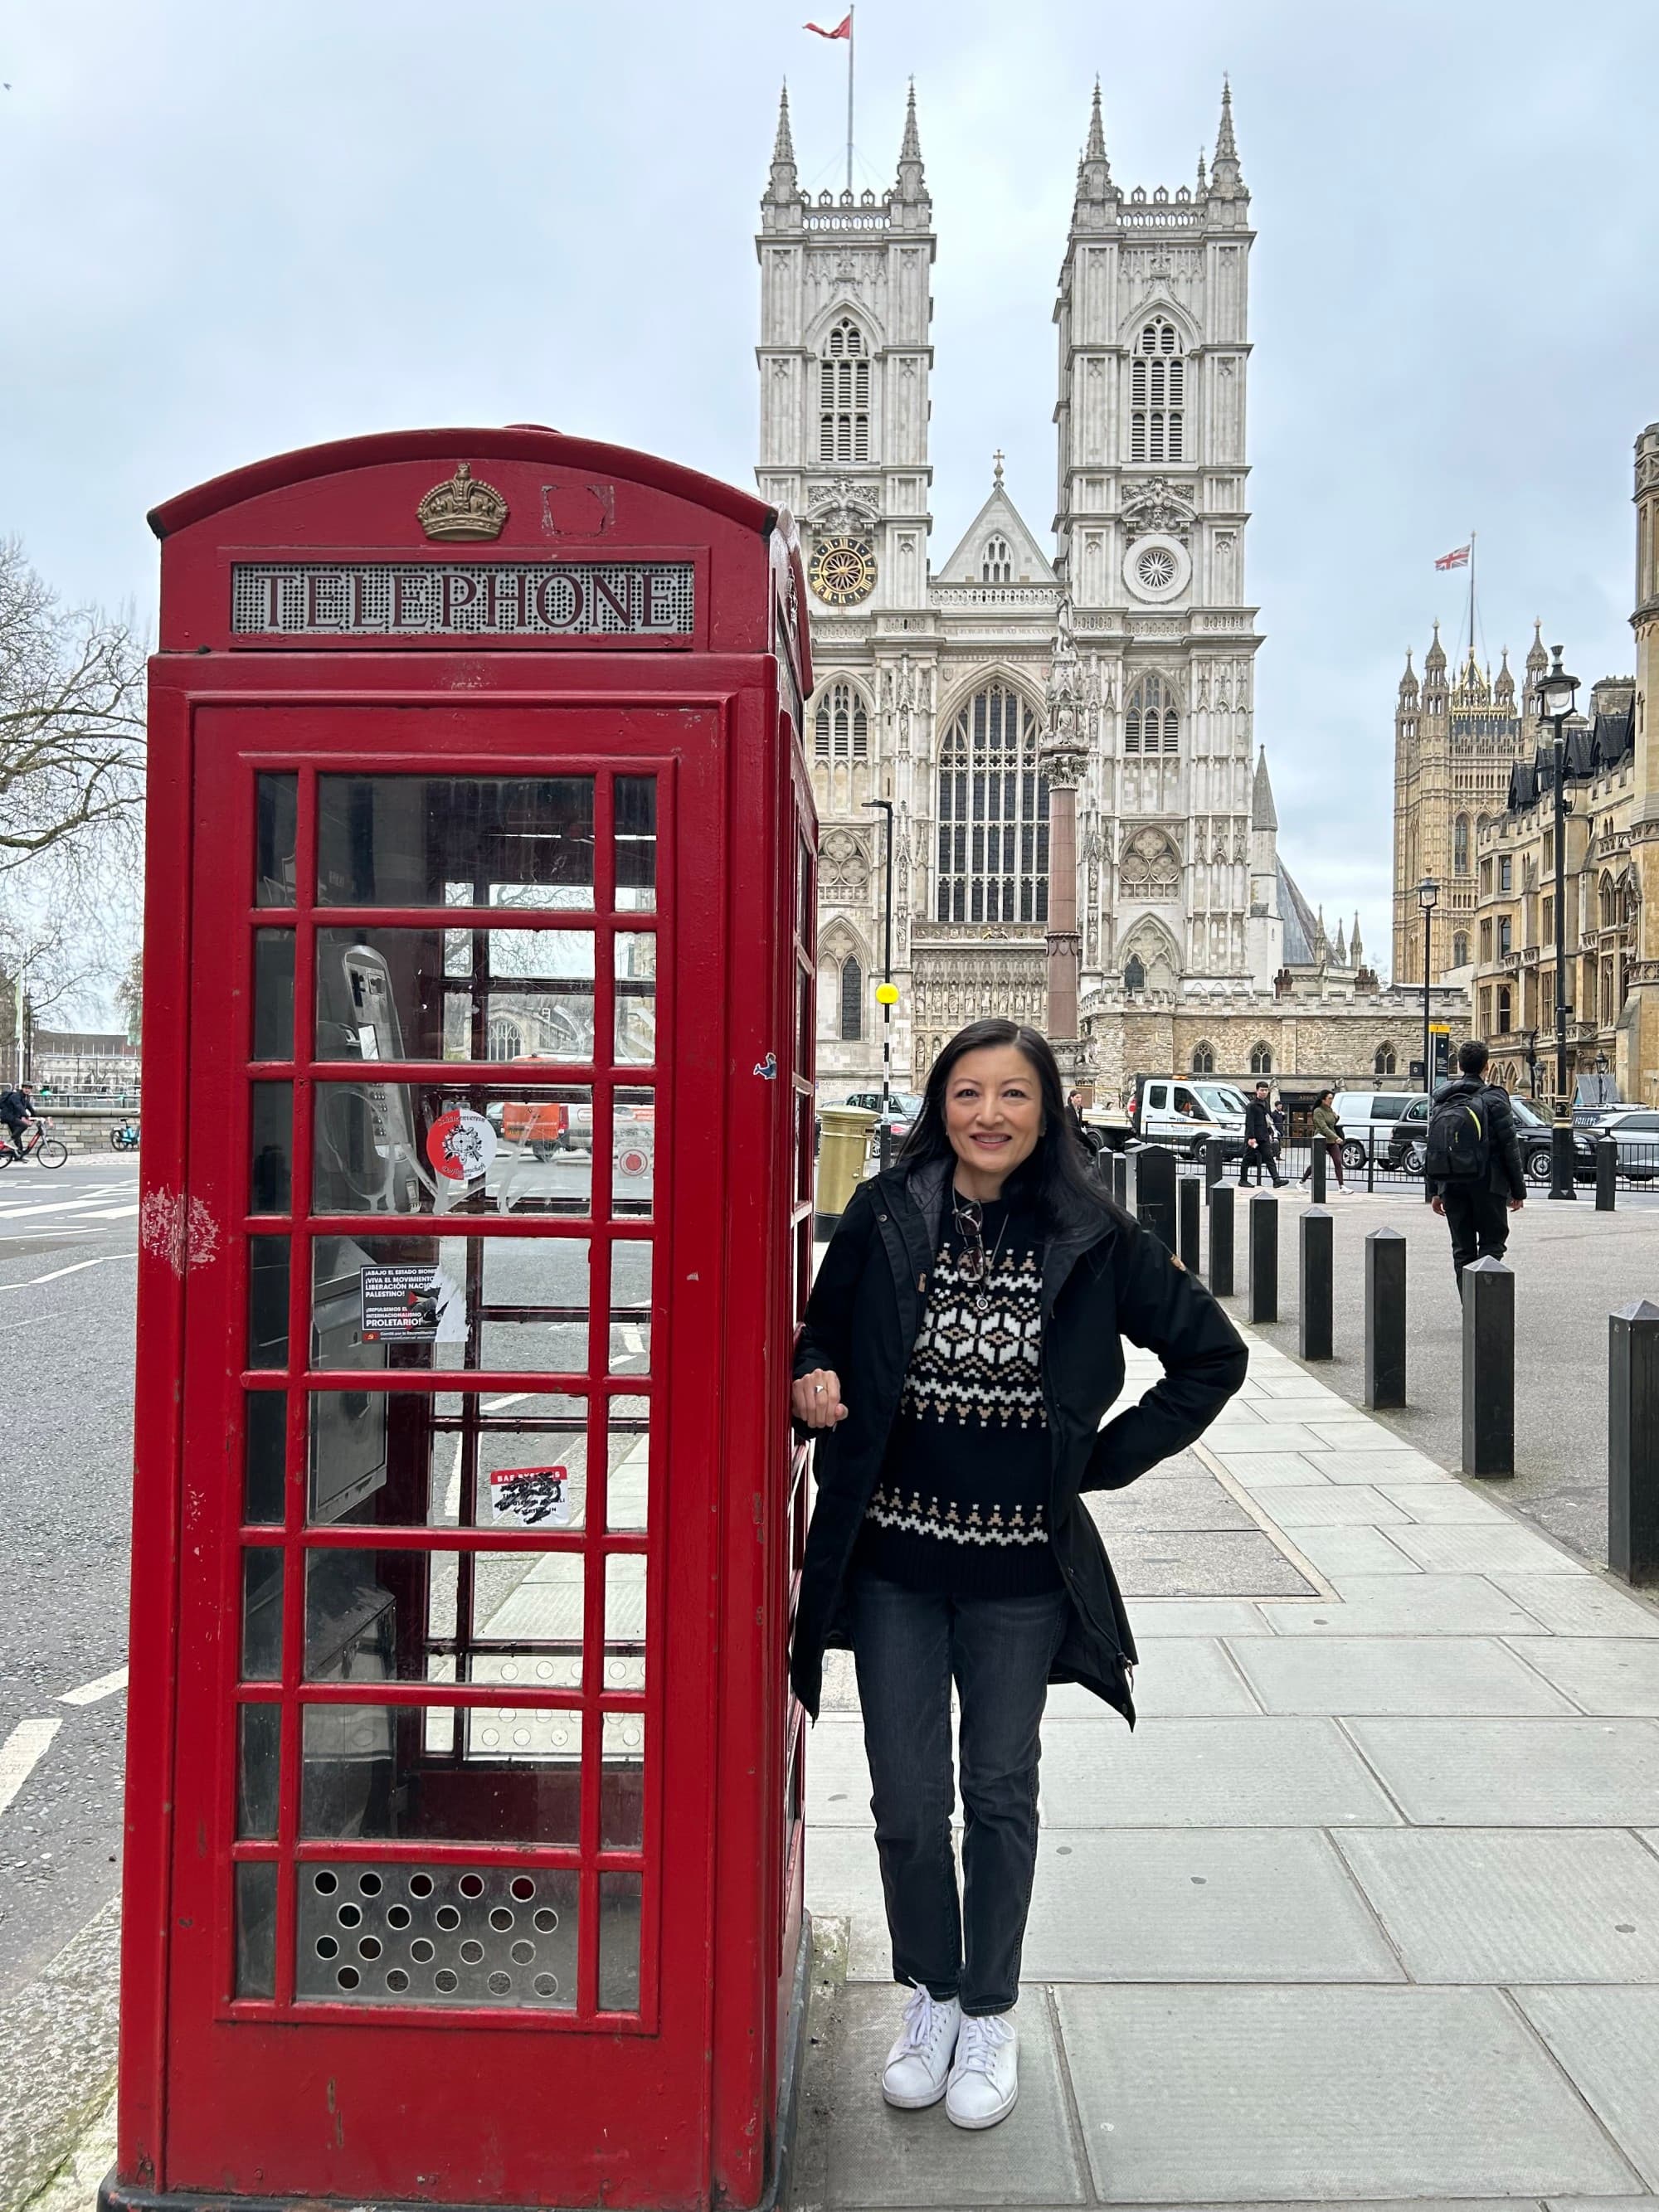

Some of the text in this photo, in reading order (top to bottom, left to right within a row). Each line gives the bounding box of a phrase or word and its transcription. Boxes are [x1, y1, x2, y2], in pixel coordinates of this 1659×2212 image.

[254, 572, 676, 629] TELEPHONE
[365, 1281, 407, 1291] LIBERACIÓN
[366, 1319, 421, 1327] PROLETARIO!
